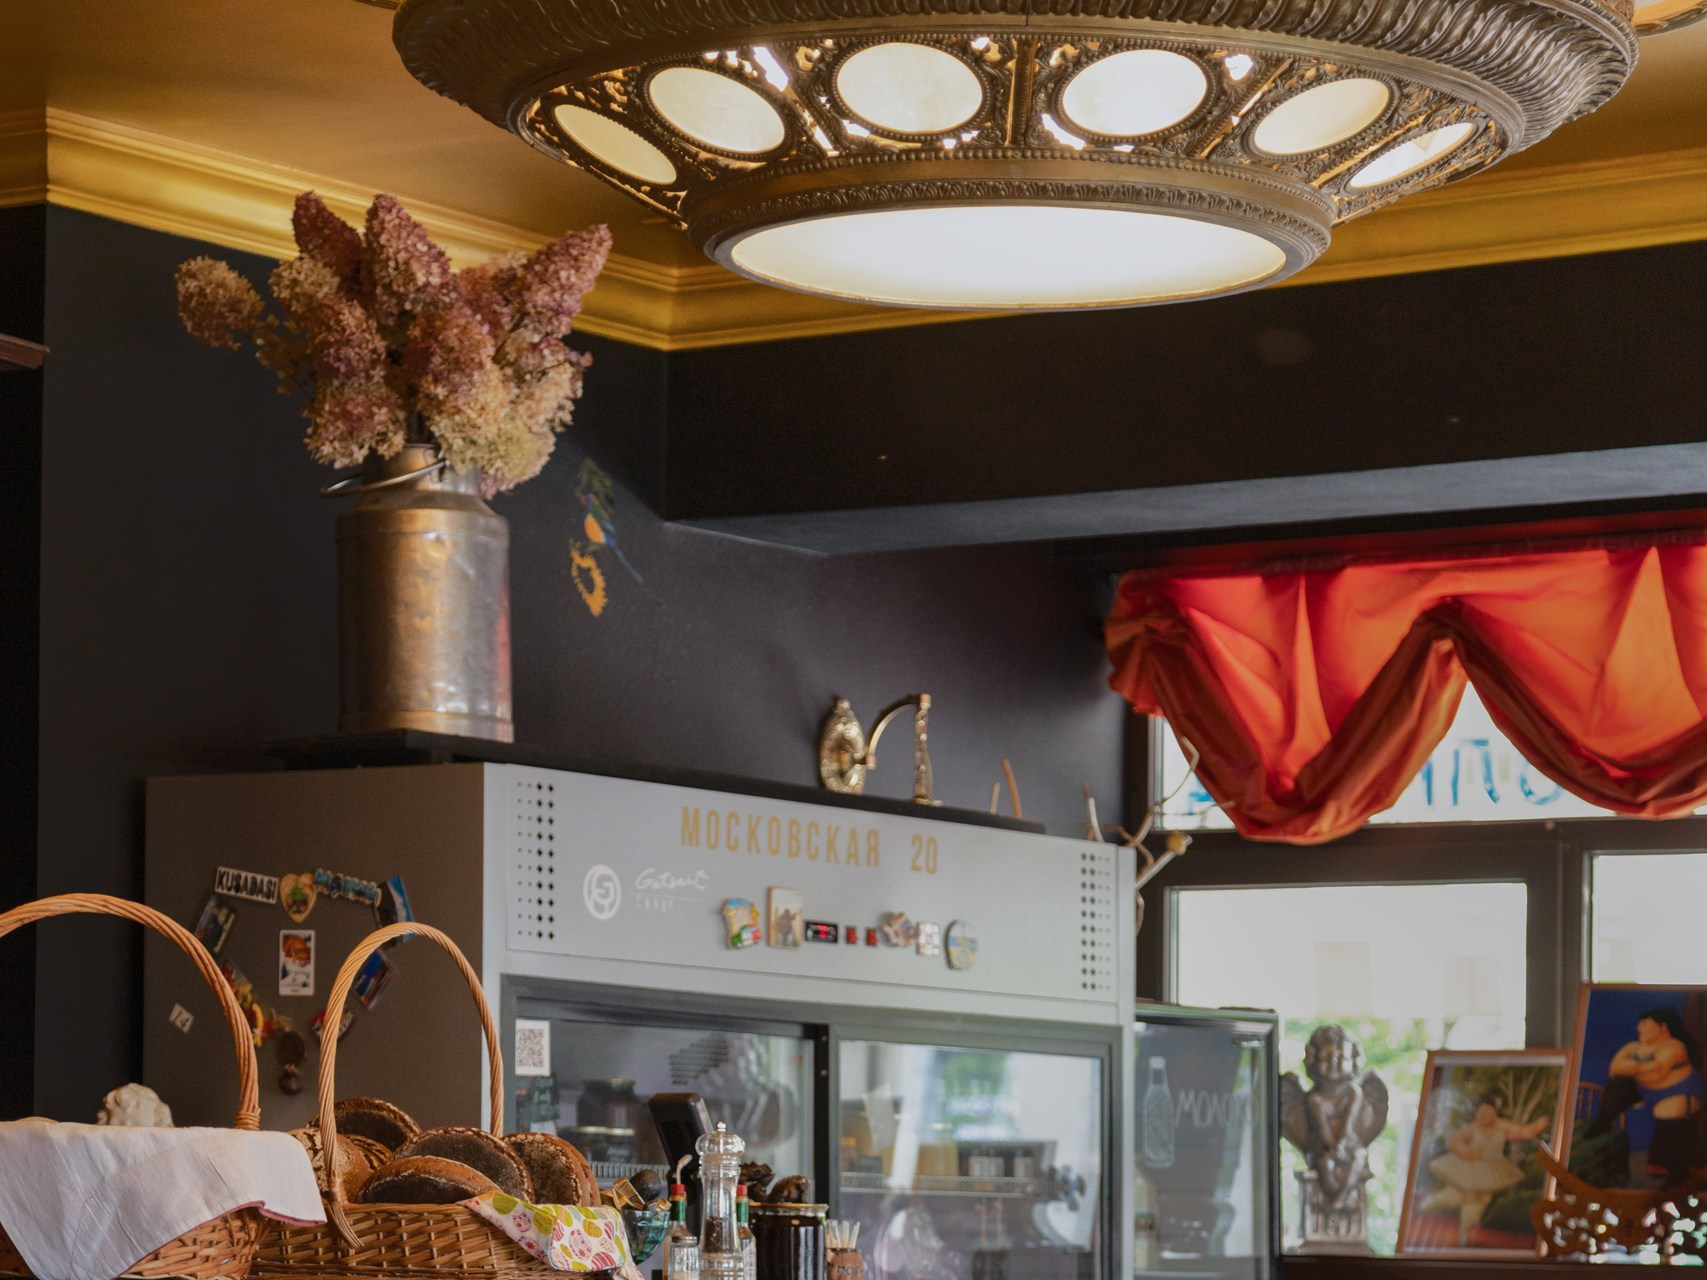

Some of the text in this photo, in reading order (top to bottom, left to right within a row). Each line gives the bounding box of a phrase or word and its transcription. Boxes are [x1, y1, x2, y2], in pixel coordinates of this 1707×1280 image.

[680, 805, 939, 875] МОСКОВСКАЯ 20
[217, 868, 278, 900] KUSADASI
